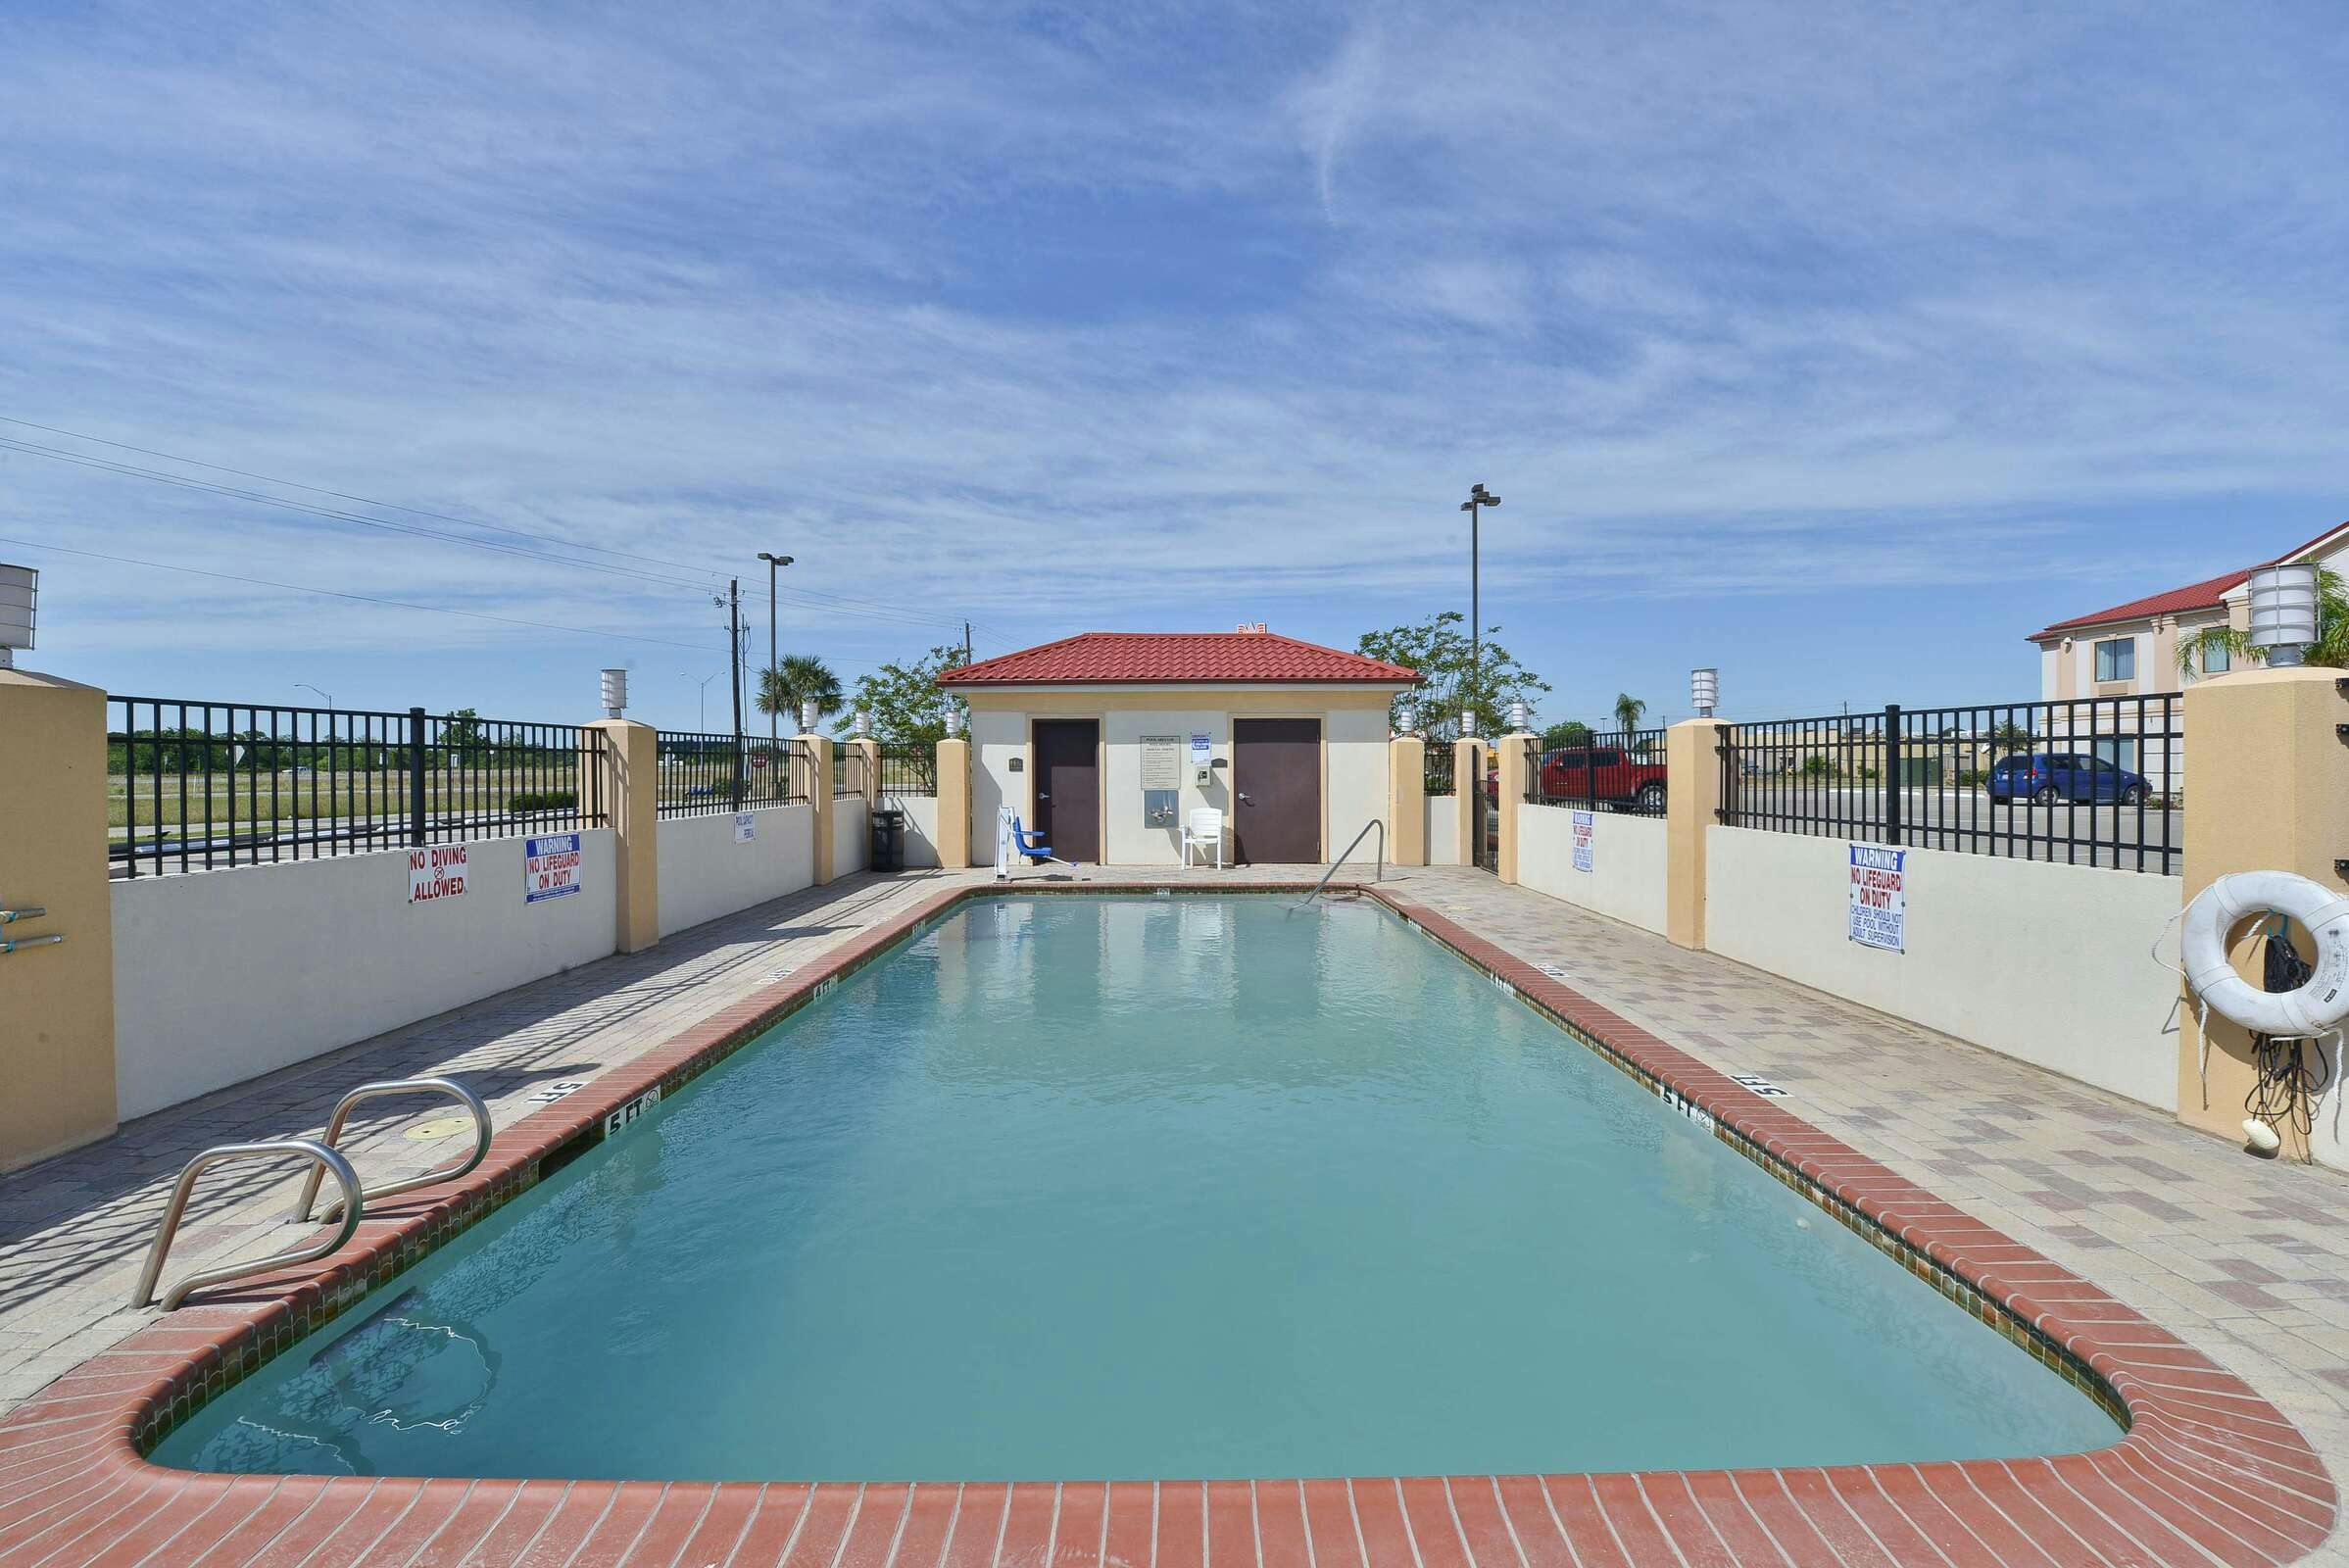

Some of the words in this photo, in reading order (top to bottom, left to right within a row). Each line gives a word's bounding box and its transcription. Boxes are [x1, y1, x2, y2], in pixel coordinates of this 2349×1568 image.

[535, 836, 573, 856] WARNING
[410, 851, 425, 870] NO
[431, 846, 466, 868] DIVING
[529, 858, 540, 873] NO
[542, 853, 579, 871] LIFEGUARD
[1855, 847, 1898, 870] WARNING
[414, 876, 464, 902] ALLOWED
[539, 874, 549, 890] ON
[553, 869, 571, 886] DUTY
[1850, 866, 1861, 885] NO
[1862, 867, 1901, 892] LIFEGUARD
[1859, 886, 1871, 905] ON
[1872, 889, 1891, 909] DUTY
[1863, 917, 1876, 930] POOL
[527, 1091, 566, 1103] FT
[1662, 1085, 1673, 1104] 5
[609, 1111, 621, 1136] 5
[625, 1098, 643, 1124] FT
